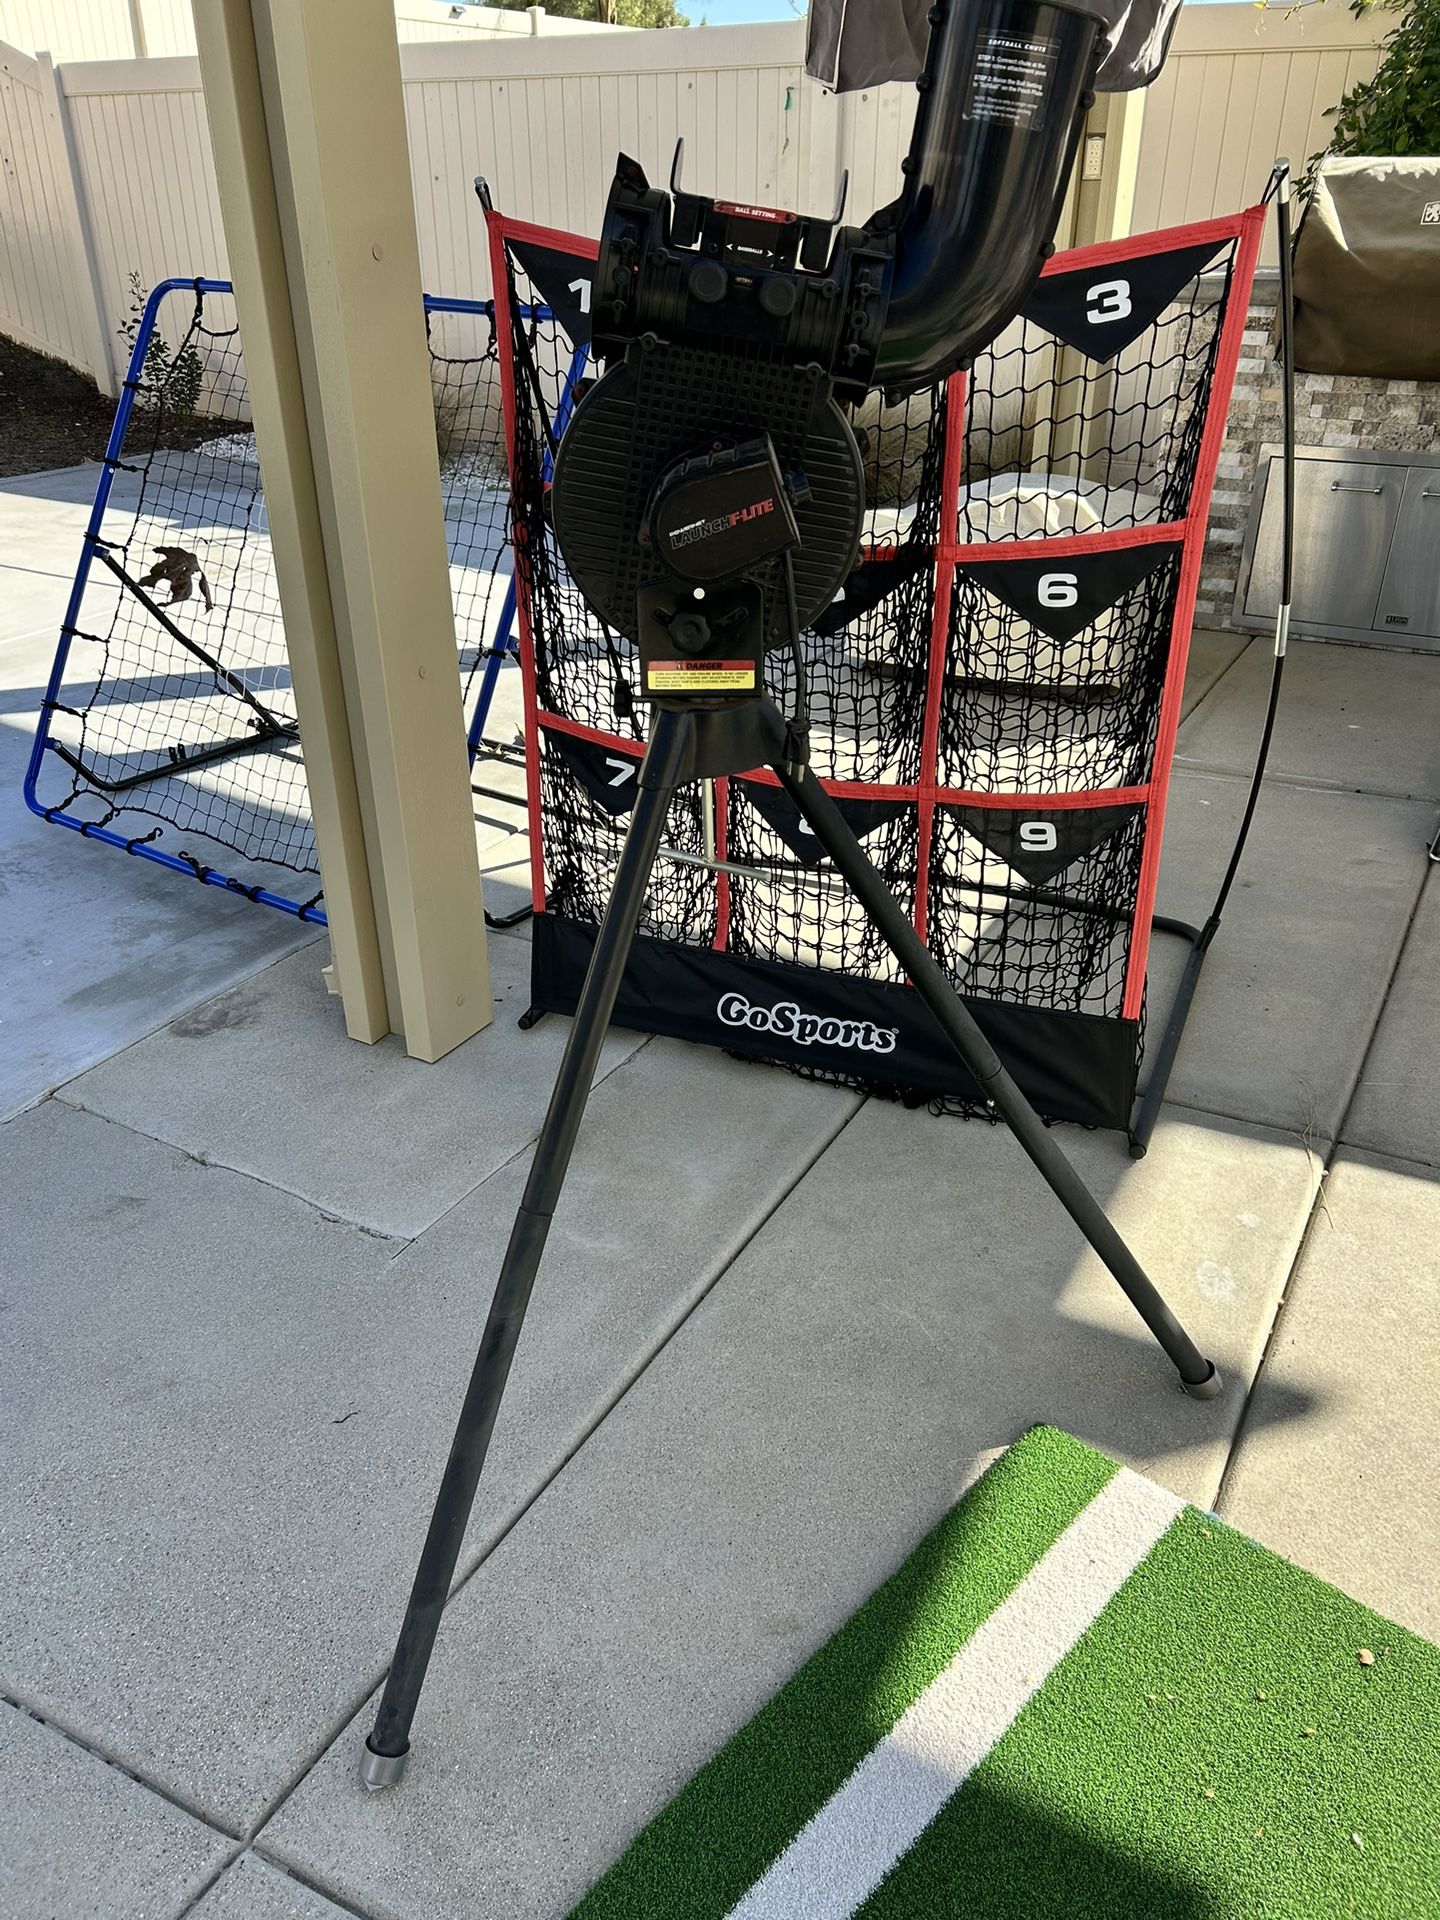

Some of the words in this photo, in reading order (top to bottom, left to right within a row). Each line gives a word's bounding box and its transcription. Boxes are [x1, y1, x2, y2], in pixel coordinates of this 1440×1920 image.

[988, 39, 1022, 48] SOFTBALL
[1024, 44, 1046, 52] CHUTE
[735, 206, 750, 214] BALL
[751, 209, 776, 219] SETTING
[737, 245, 763, 254] BASEBALLS
[568, 278, 591, 314] 1
[1086, 279, 1132, 324] 3
[1038, 573, 1078, 608] 6
[686, 662, 723, 670] DANGER
[605, 756, 636, 787] 7
[1020, 821, 1057, 851] 9
[716, 992, 896, 1054] GoSports
